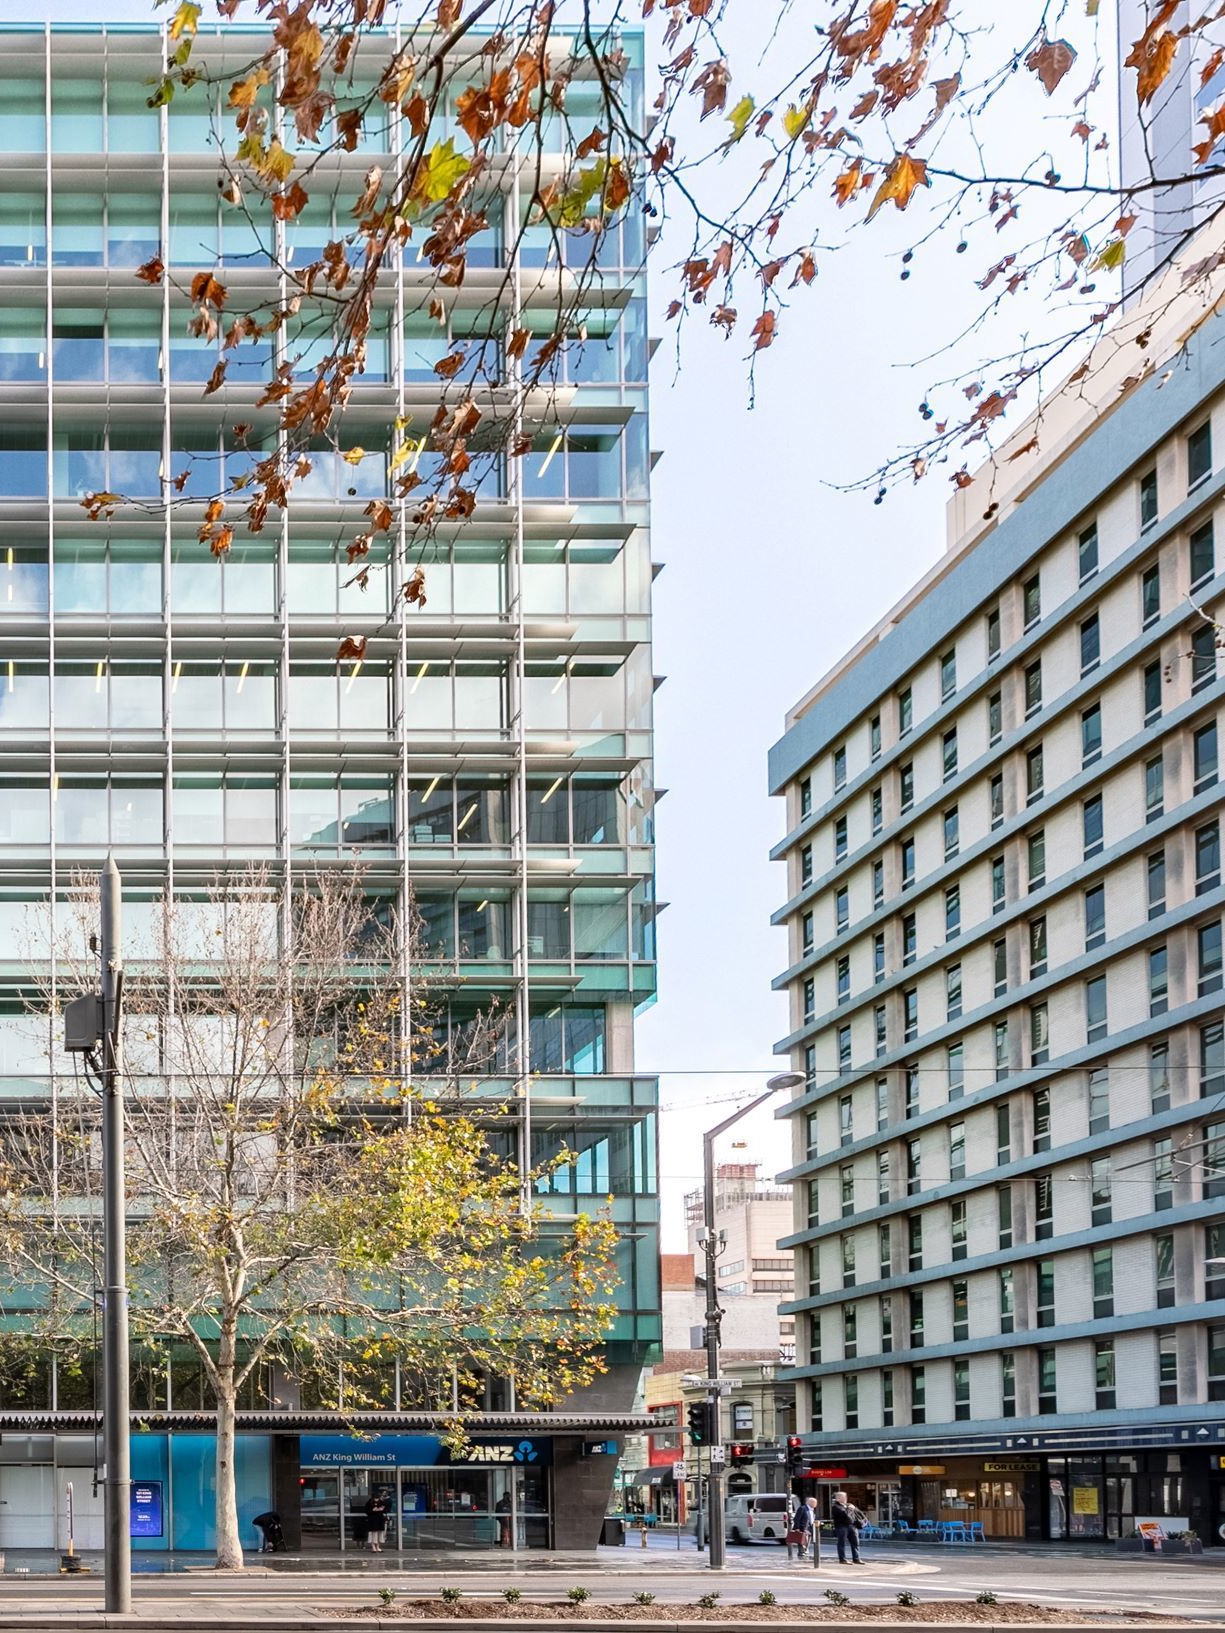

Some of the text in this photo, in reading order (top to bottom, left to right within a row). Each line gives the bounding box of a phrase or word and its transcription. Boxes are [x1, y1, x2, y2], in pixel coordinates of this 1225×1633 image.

[313, 1453, 396, 1463] ANZ King William St
[468, 1446, 515, 1462] ANZ
[988, 1463, 1038, 1471] FOR LEASE
